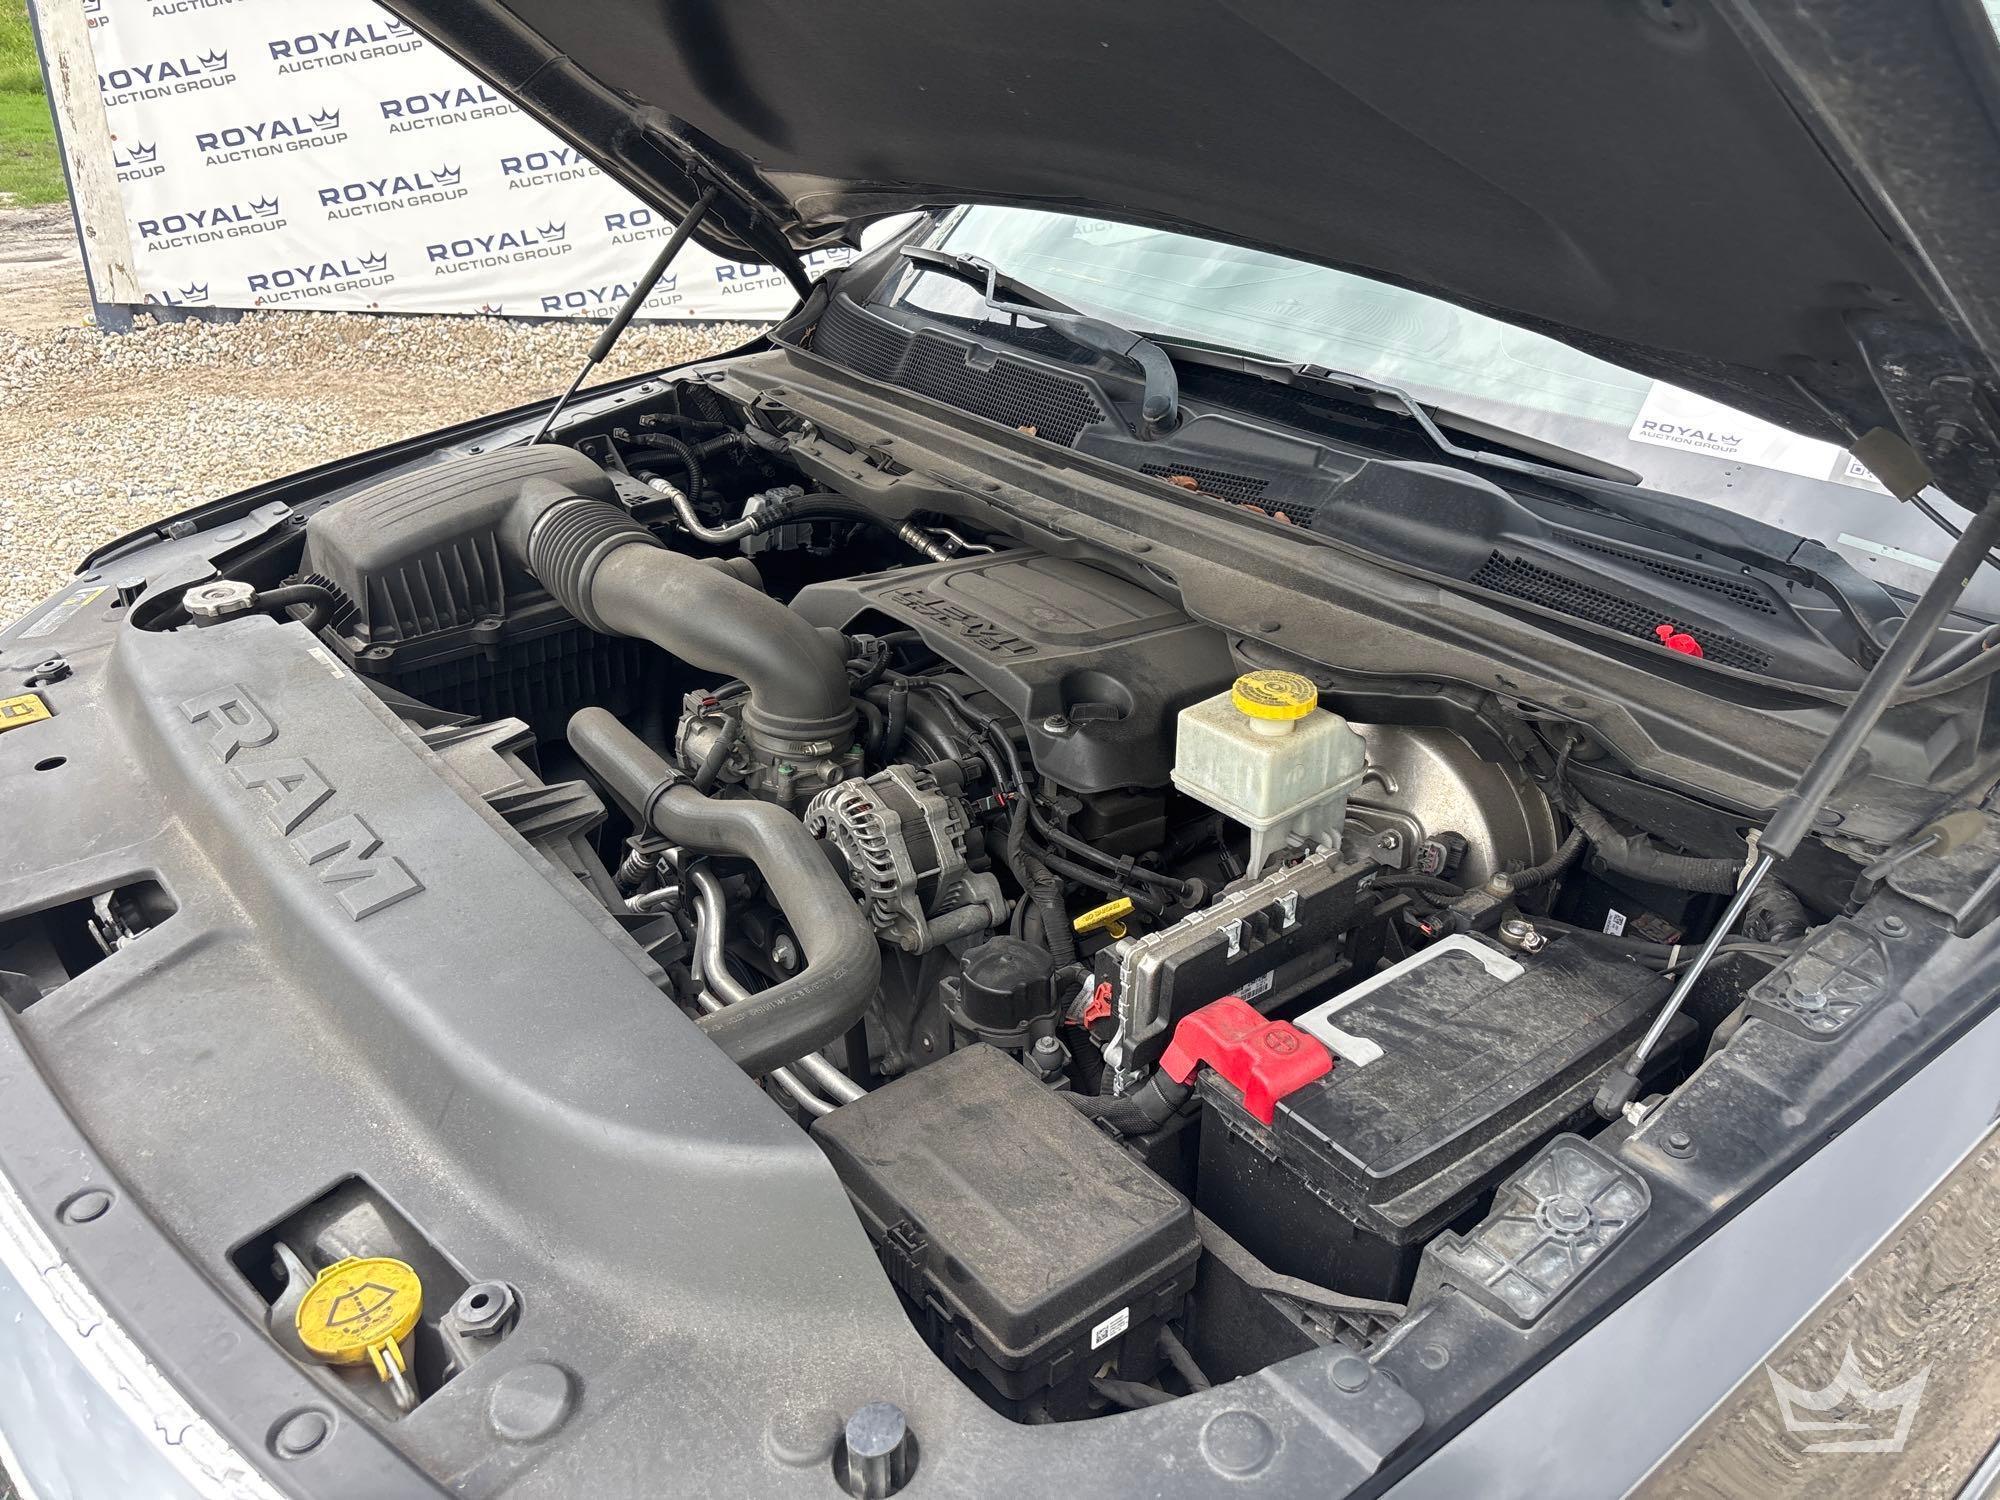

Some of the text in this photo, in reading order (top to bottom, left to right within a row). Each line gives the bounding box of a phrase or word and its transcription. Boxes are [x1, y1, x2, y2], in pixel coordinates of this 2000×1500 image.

[268, 24, 388, 60] ROYAL
[278, 40, 423, 75] AUCTION GROUP
[104, 73, 236, 107] UCTION GROUP
[379, 85, 498, 119] ROYAL
[195, 117, 313, 152] ROYAL
[389, 103, 520, 134] AUCTION GROU
[206, 132, 348, 167] AUCTION GROUP
[117, 165, 166, 183] ROUP
[318, 173, 434, 207] ROYAL
[508, 168, 585, 190] AUCTION
[327, 188, 468, 221] AUCTION GROUP
[138, 204, 252, 239] ROYAL
[148, 219, 287, 252] AUCTION GROUP
[611, 226, 673, 246] AUCTIO
[426, 229, 539, 262] ROYAL
[435, 244, 572, 276] AUCTION GROUP
[248, 260, 361, 292] ROYAL
[257, 274, 395, 305] AUCTION GROUP
[642, 294, 683, 311] OUP
[1640, 430, 1738, 453] AUCTION GROUP
[1642, 420, 1718, 442] ROYAL
[178, 682, 426, 921] RAM
